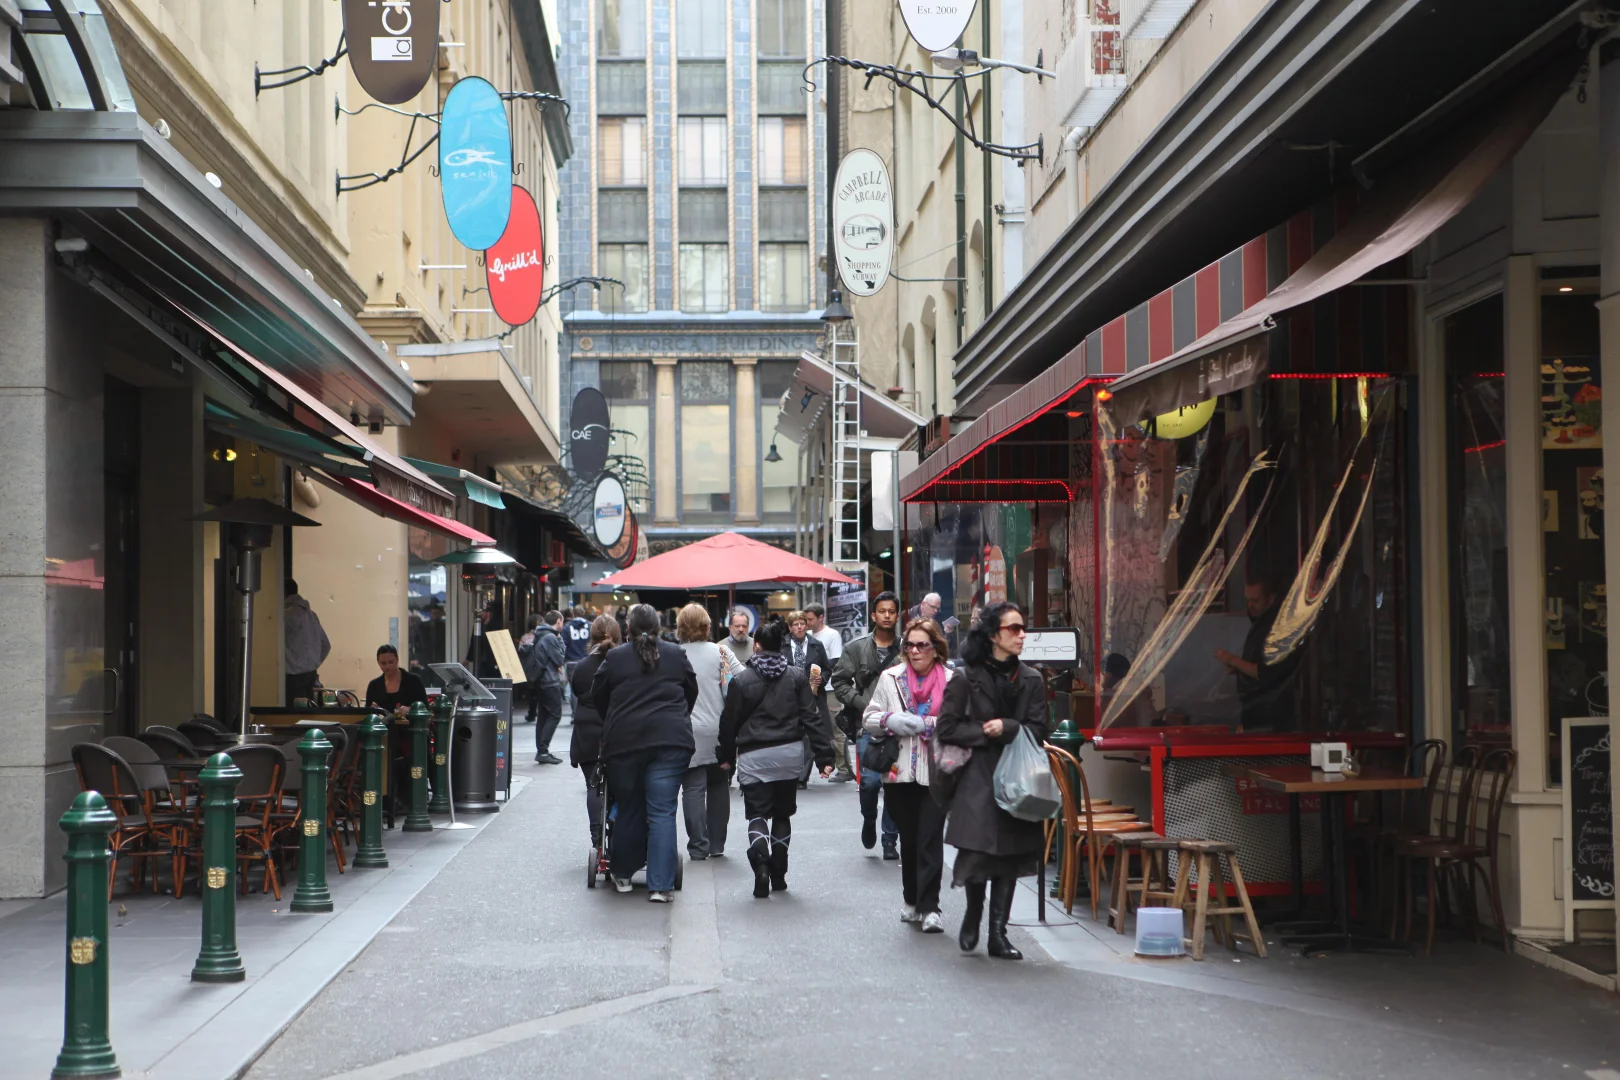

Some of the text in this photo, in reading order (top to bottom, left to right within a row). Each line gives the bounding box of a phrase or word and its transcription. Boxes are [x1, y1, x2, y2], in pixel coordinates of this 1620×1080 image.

[935, 5, 957, 14] 2000
[838, 170, 883, 202] CAMPBELL
[854, 189, 888, 204] ARCADE
[489, 249, 541, 282] Grill'd
[847, 261, 881, 270] SHOPPING
[852, 272, 878, 281] SUBWAY
[717, 336, 803, 351] BUILDING
[571, 430, 592, 440] CAE
